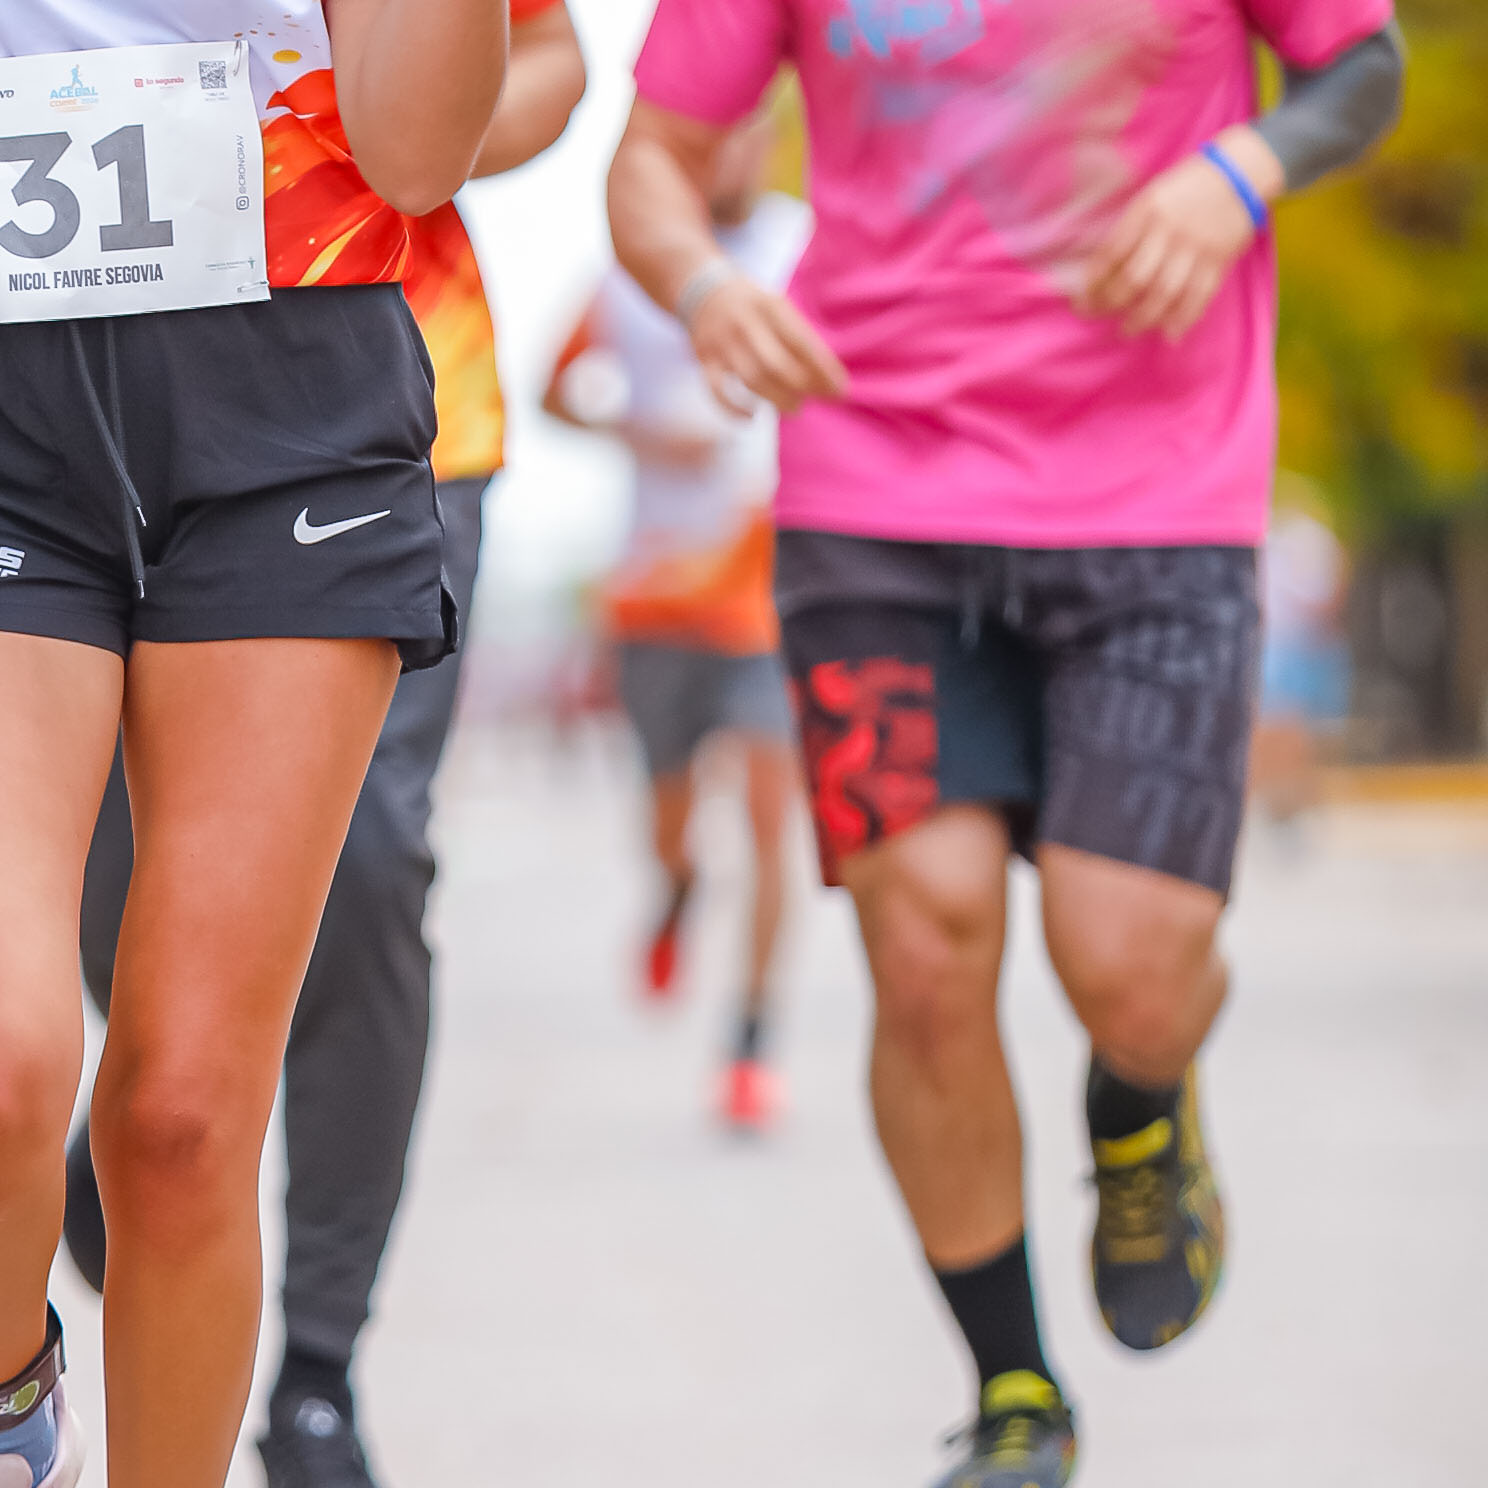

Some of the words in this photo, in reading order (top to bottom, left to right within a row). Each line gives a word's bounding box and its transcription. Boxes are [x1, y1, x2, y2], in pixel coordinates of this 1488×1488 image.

[9, 272, 50, 292] NICOL
[53, 268, 103, 289] FAIVRE
[105, 263, 164, 285] SEGOVIA
